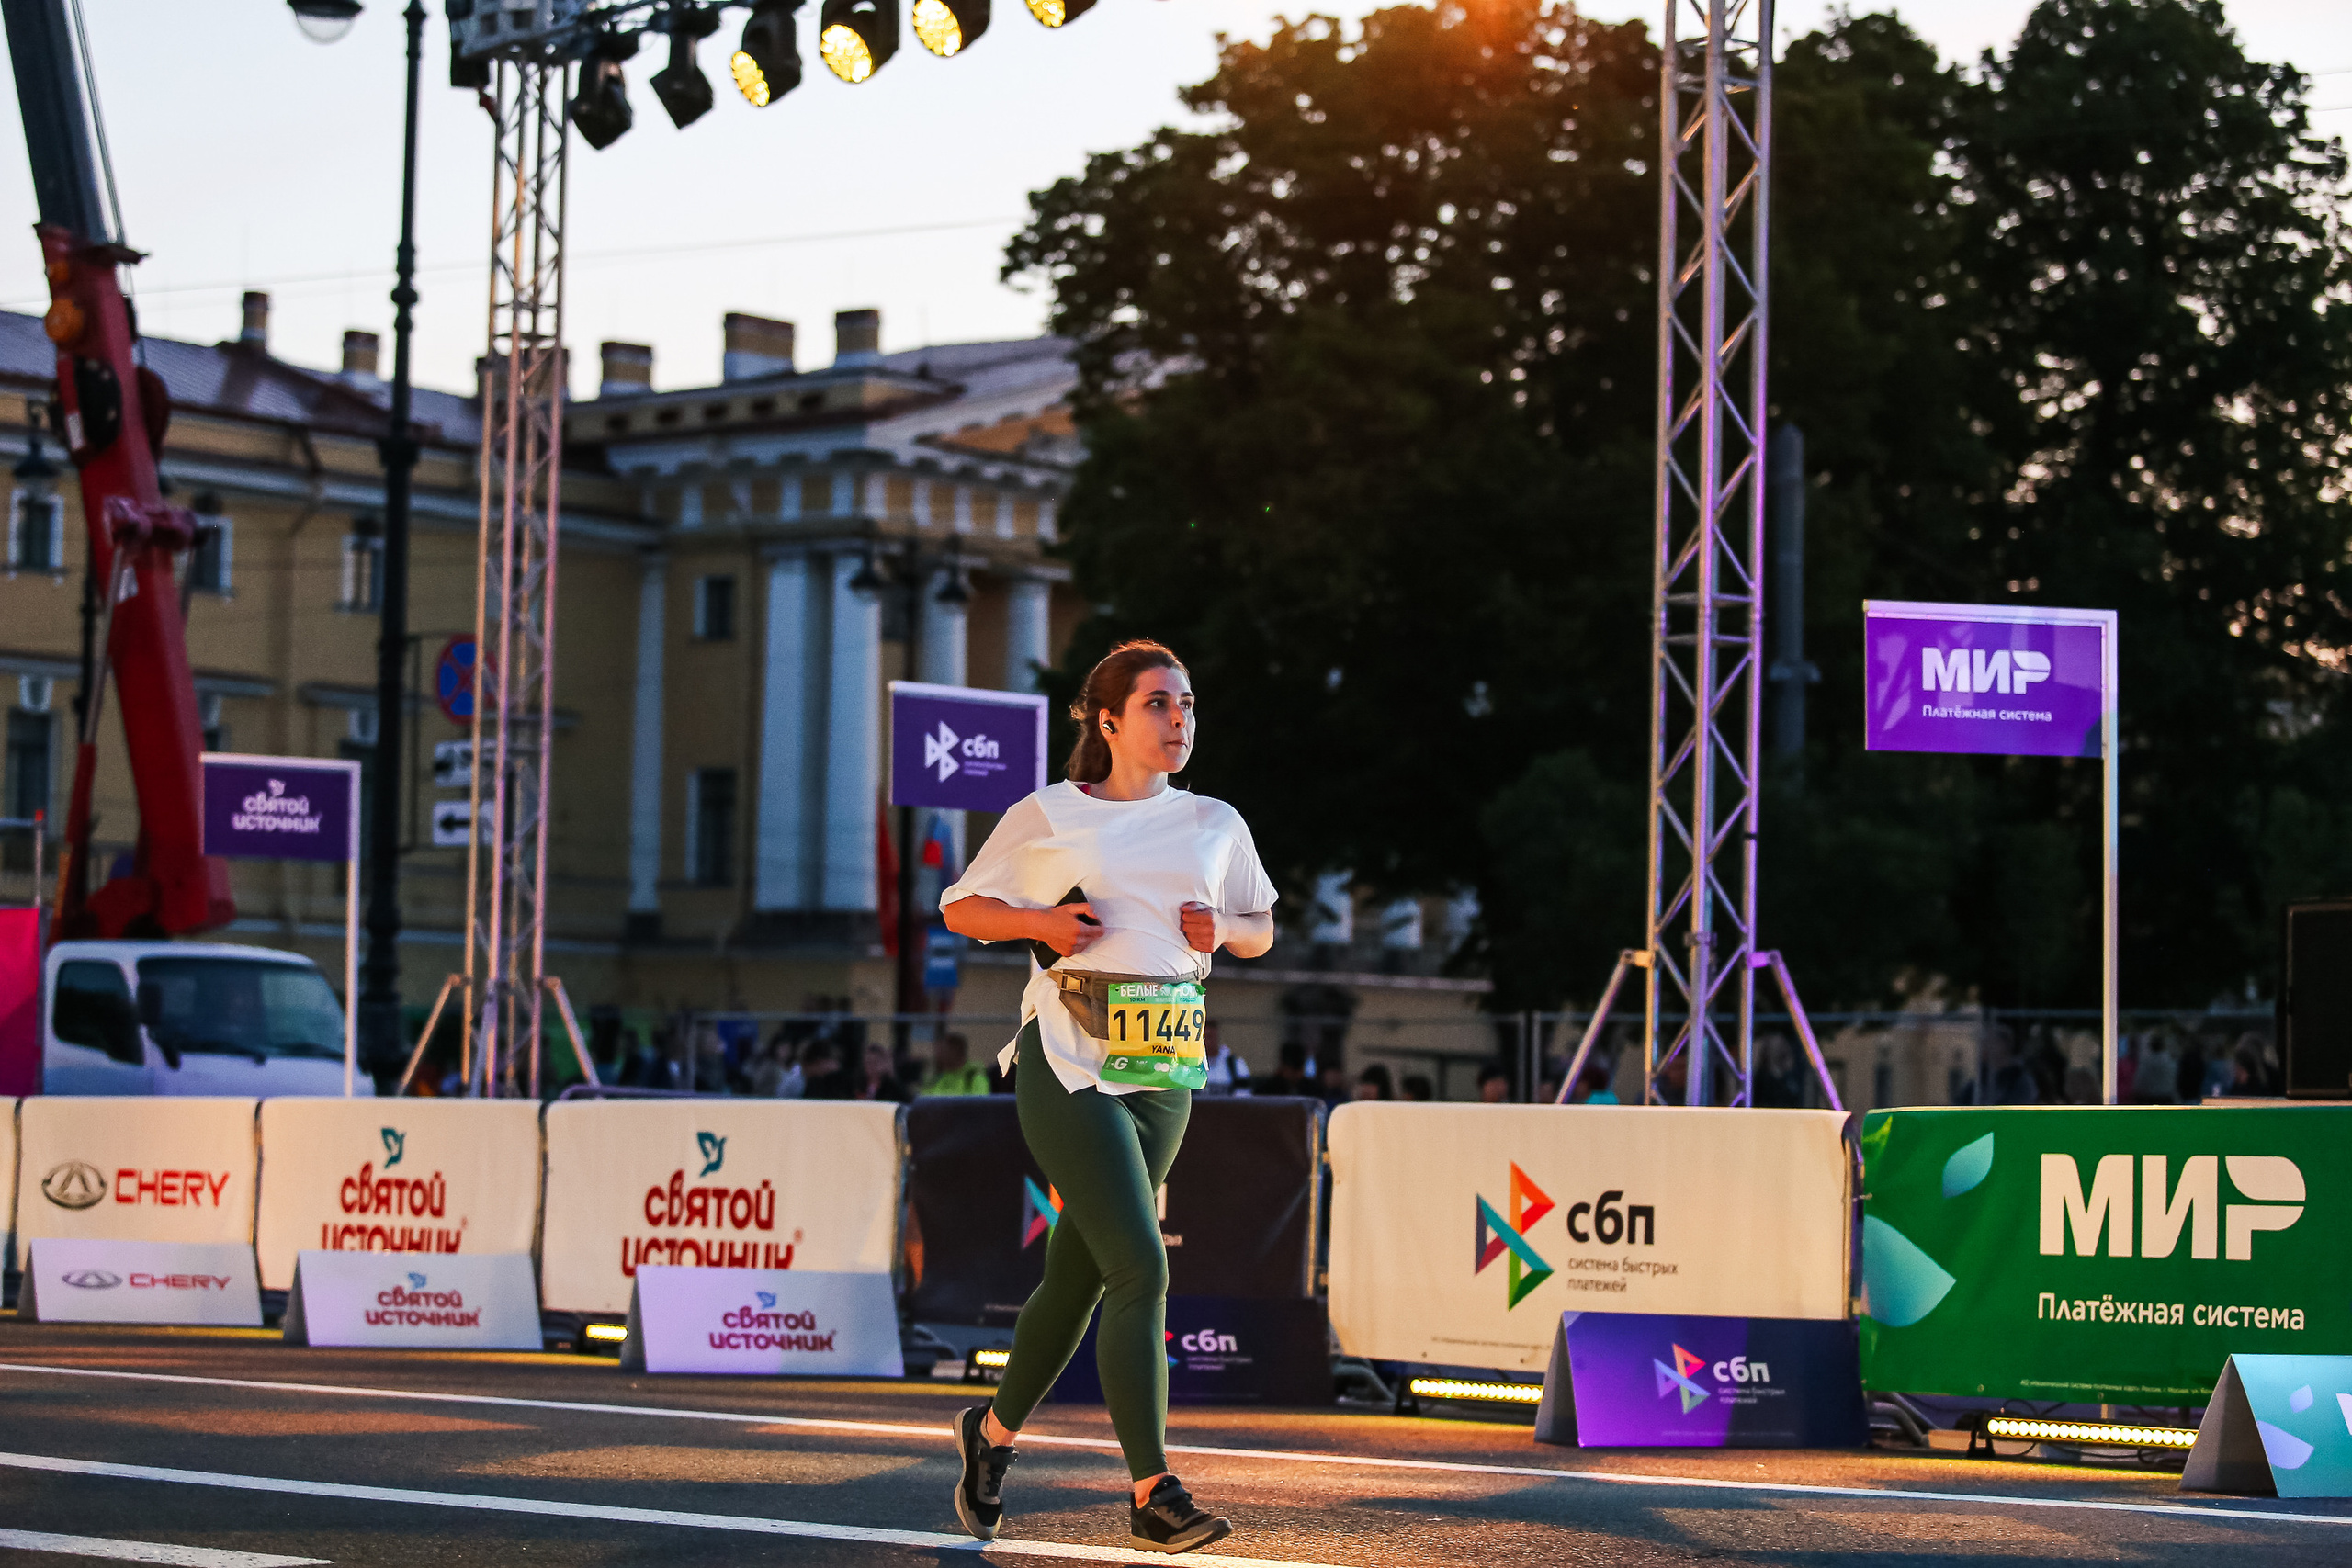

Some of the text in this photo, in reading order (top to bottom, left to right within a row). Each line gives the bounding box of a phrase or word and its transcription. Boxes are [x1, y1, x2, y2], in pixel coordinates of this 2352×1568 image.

[1922, 647, 2051, 694] МИР
[1922, 705, 2052, 722] Платёжная система
[1121, 984, 1158, 997] БЕЛЫЕ
[1113, 1009, 1204, 1042] 11449
[1151, 1045, 1175, 1055] YANA
[114, 1168, 230, 1208] CHERY
[2039, 1153, 2306, 1260] МИР
[1567, 1256, 1679, 1277] система быстрых
[130, 1273, 231, 1290] CHERY
[1567, 1276, 1627, 1292] платежей
[2037, 1292, 2305, 1331] Платёжная система
